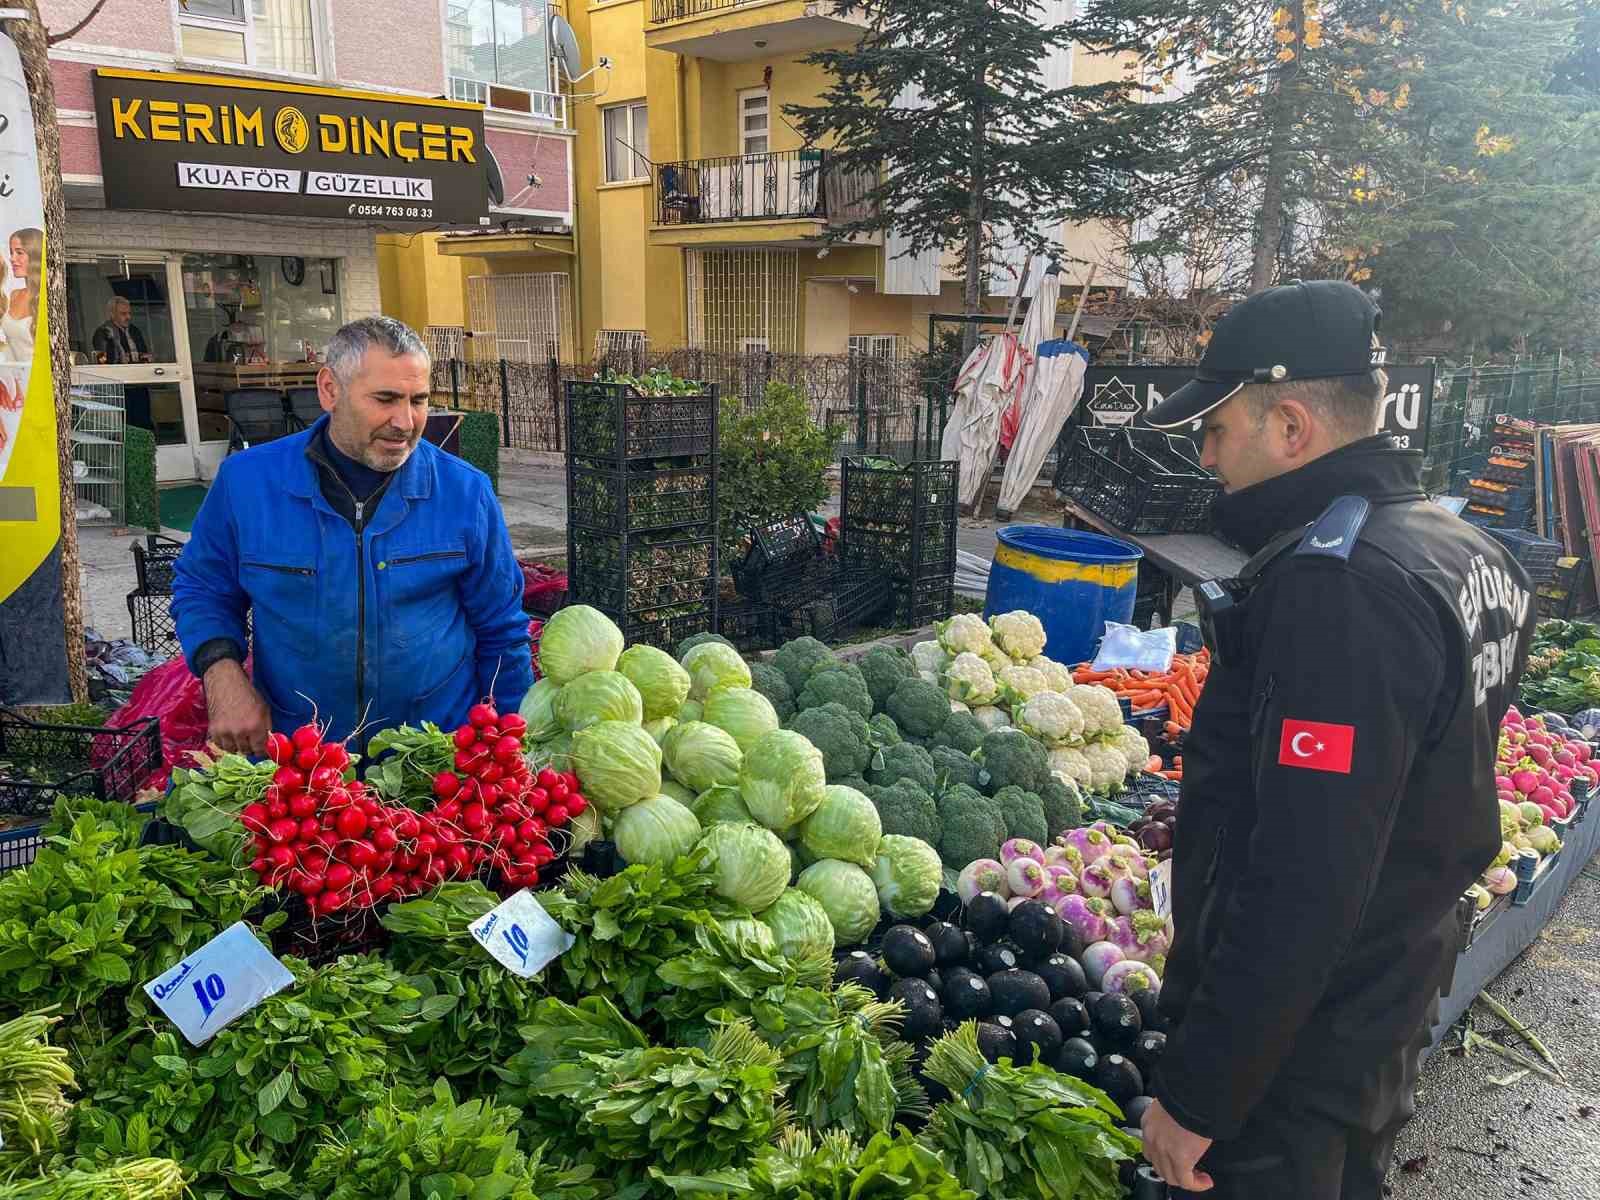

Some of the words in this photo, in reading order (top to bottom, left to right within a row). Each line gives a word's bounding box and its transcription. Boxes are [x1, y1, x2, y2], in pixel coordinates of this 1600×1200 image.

[111, 97, 265, 147] KERİM
[319, 113, 478, 164] DİNÇER
[186, 167, 290, 190] KUAFÖR
[315, 173, 426, 198] GÜZELLİK
[358, 205, 383, 215] 0554
[385, 206, 404, 217] 763
[406, 207, 418, 217] 08
[420, 208, 433, 218] 33
[502, 923, 529, 965] 10
[192, 973, 226, 1022] 10
